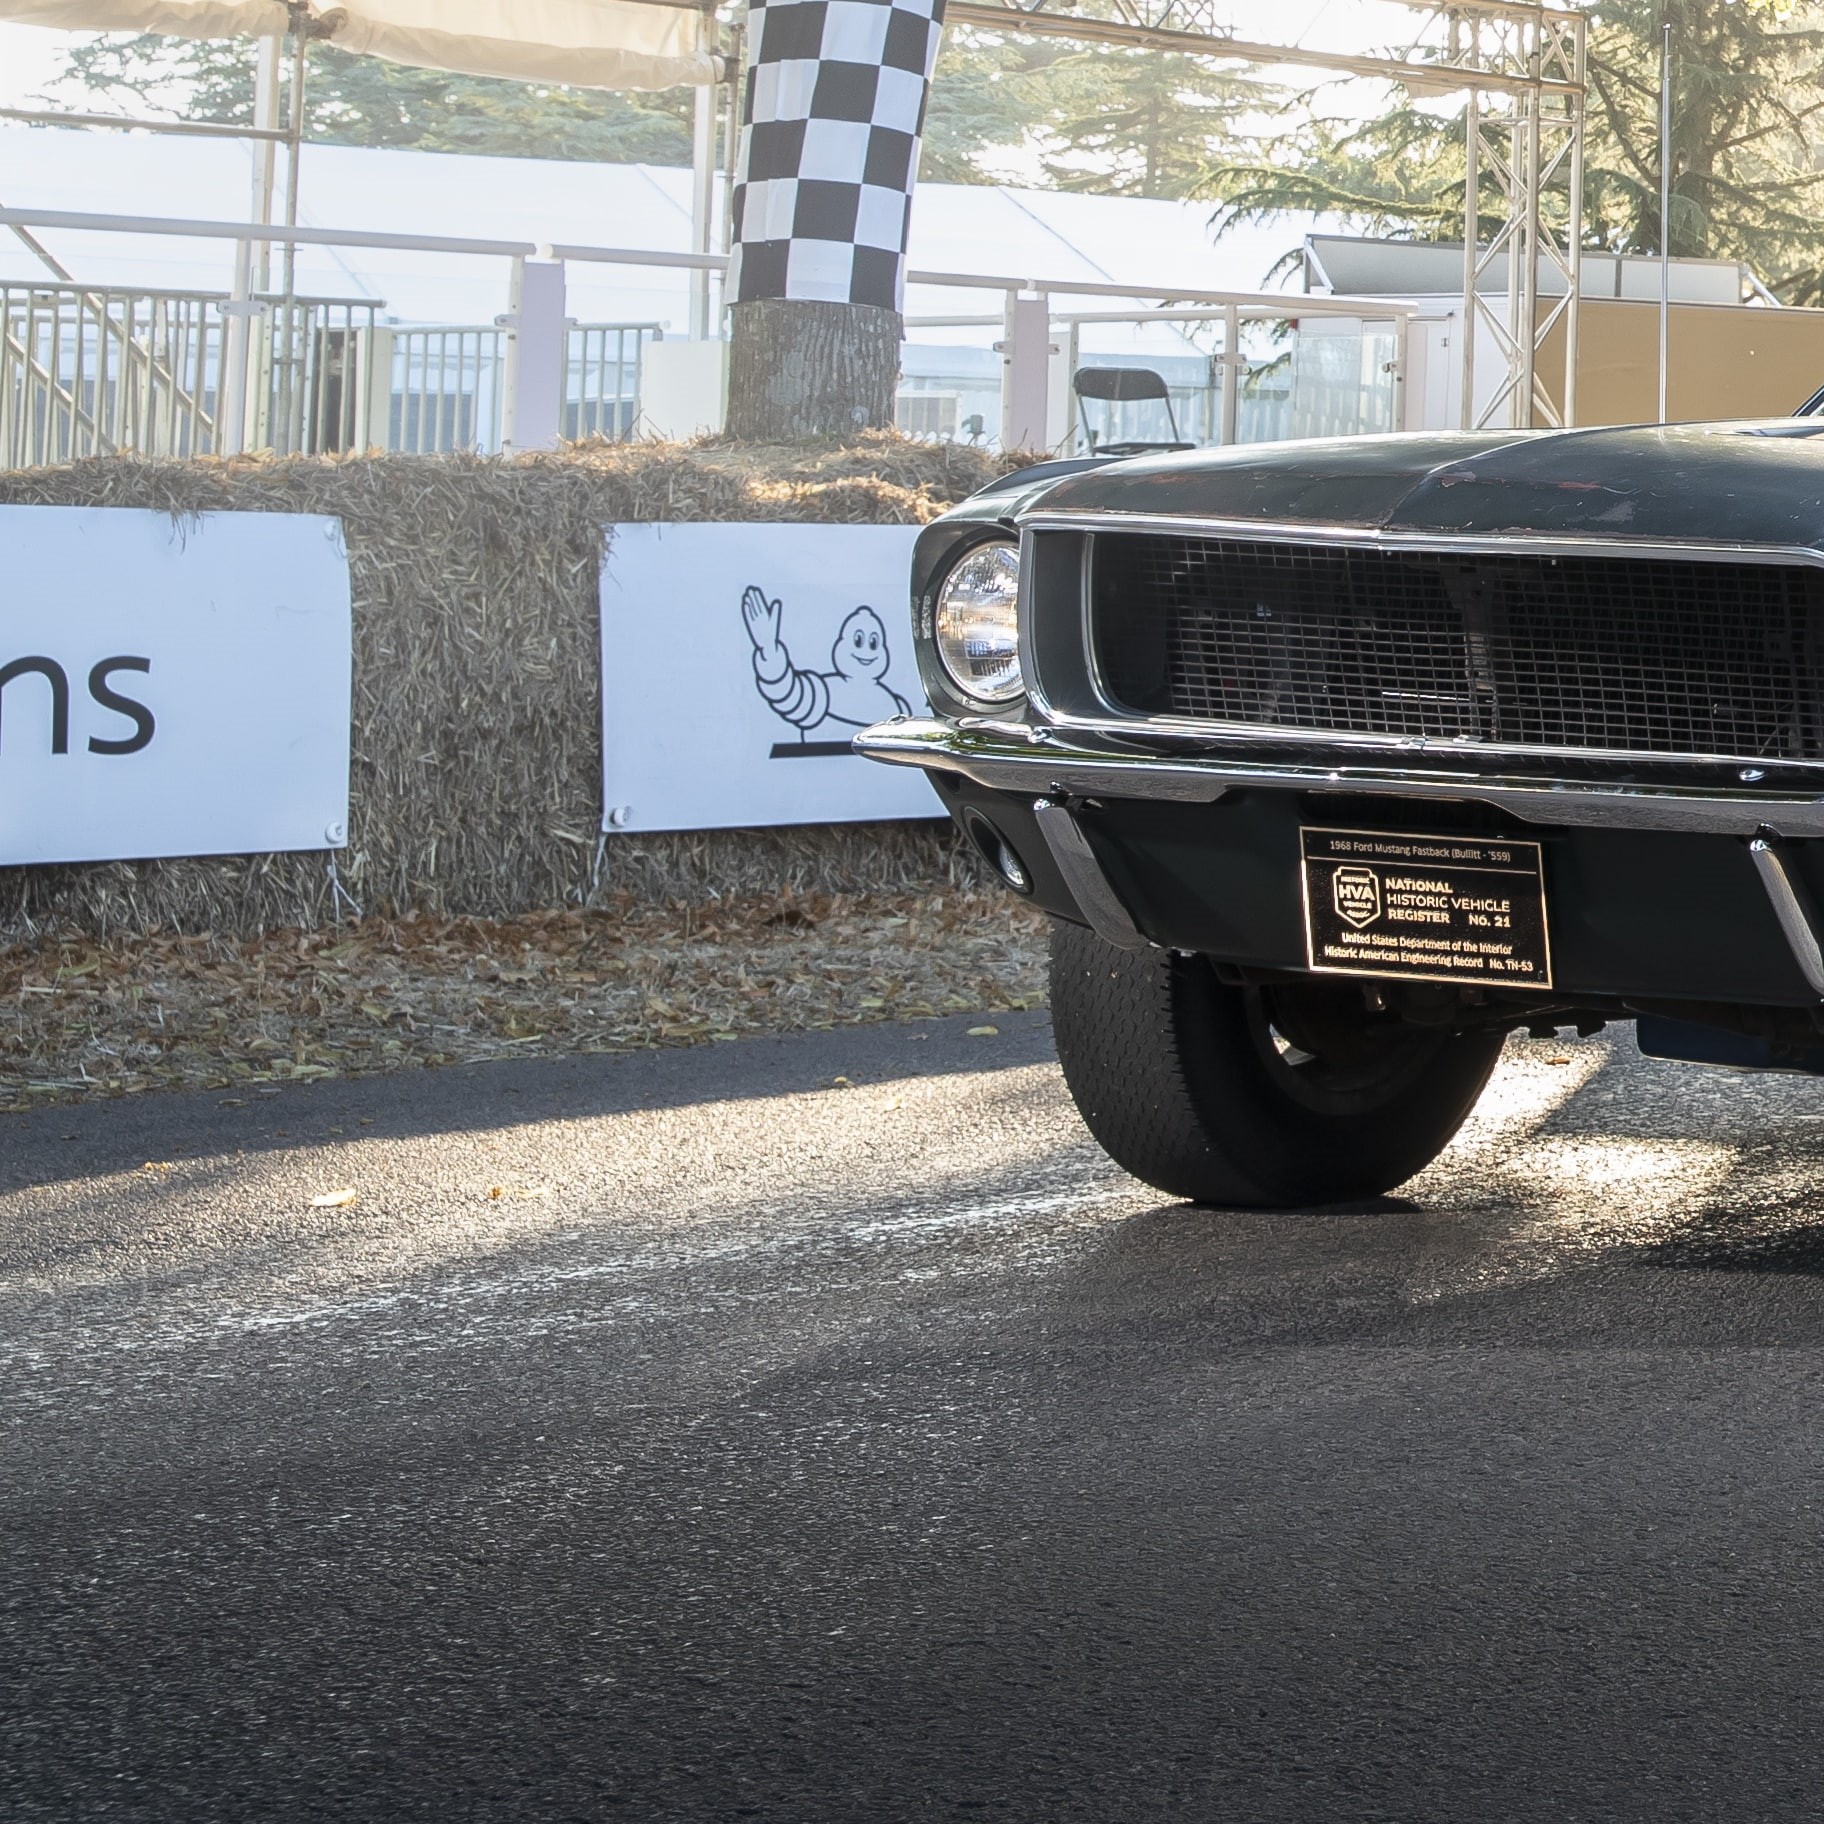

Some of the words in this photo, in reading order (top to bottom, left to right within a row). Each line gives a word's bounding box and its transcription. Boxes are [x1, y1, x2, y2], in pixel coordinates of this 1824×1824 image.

[1330, 840, 1351, 851] 1968
[1353, 841, 1373, 852] Ford
[1375, 844, 1411, 856] Mustang
[1413, 846, 1450, 857] Fastback
[1339, 884, 1375, 900] HVA
[1386, 878, 1453, 894] NATIONAL
[1387, 893, 1448, 908] HISTORIC
[1451, 897, 1511, 913] VEHICLE
[1388, 908, 1451, 923] REGISTER
[1494, 916, 1511, 927] 21
[1342, 932, 1370, 944] United
[1371, 934, 1398, 946] States
[1400, 937, 1450, 950] Department
[1452, 941, 1462, 951] of
[1463, 941, 1478, 952] the
[1480, 943, 1512, 955] Interior
[1324, 945, 1357, 958] Historic
[1359, 948, 1399, 962] American
[1401, 952, 1452, 967] Engineering
[1453, 955, 1483, 968] Record
[1489, 958, 1505, 969] No.
[1505, 959, 1534, 971] TN-53
